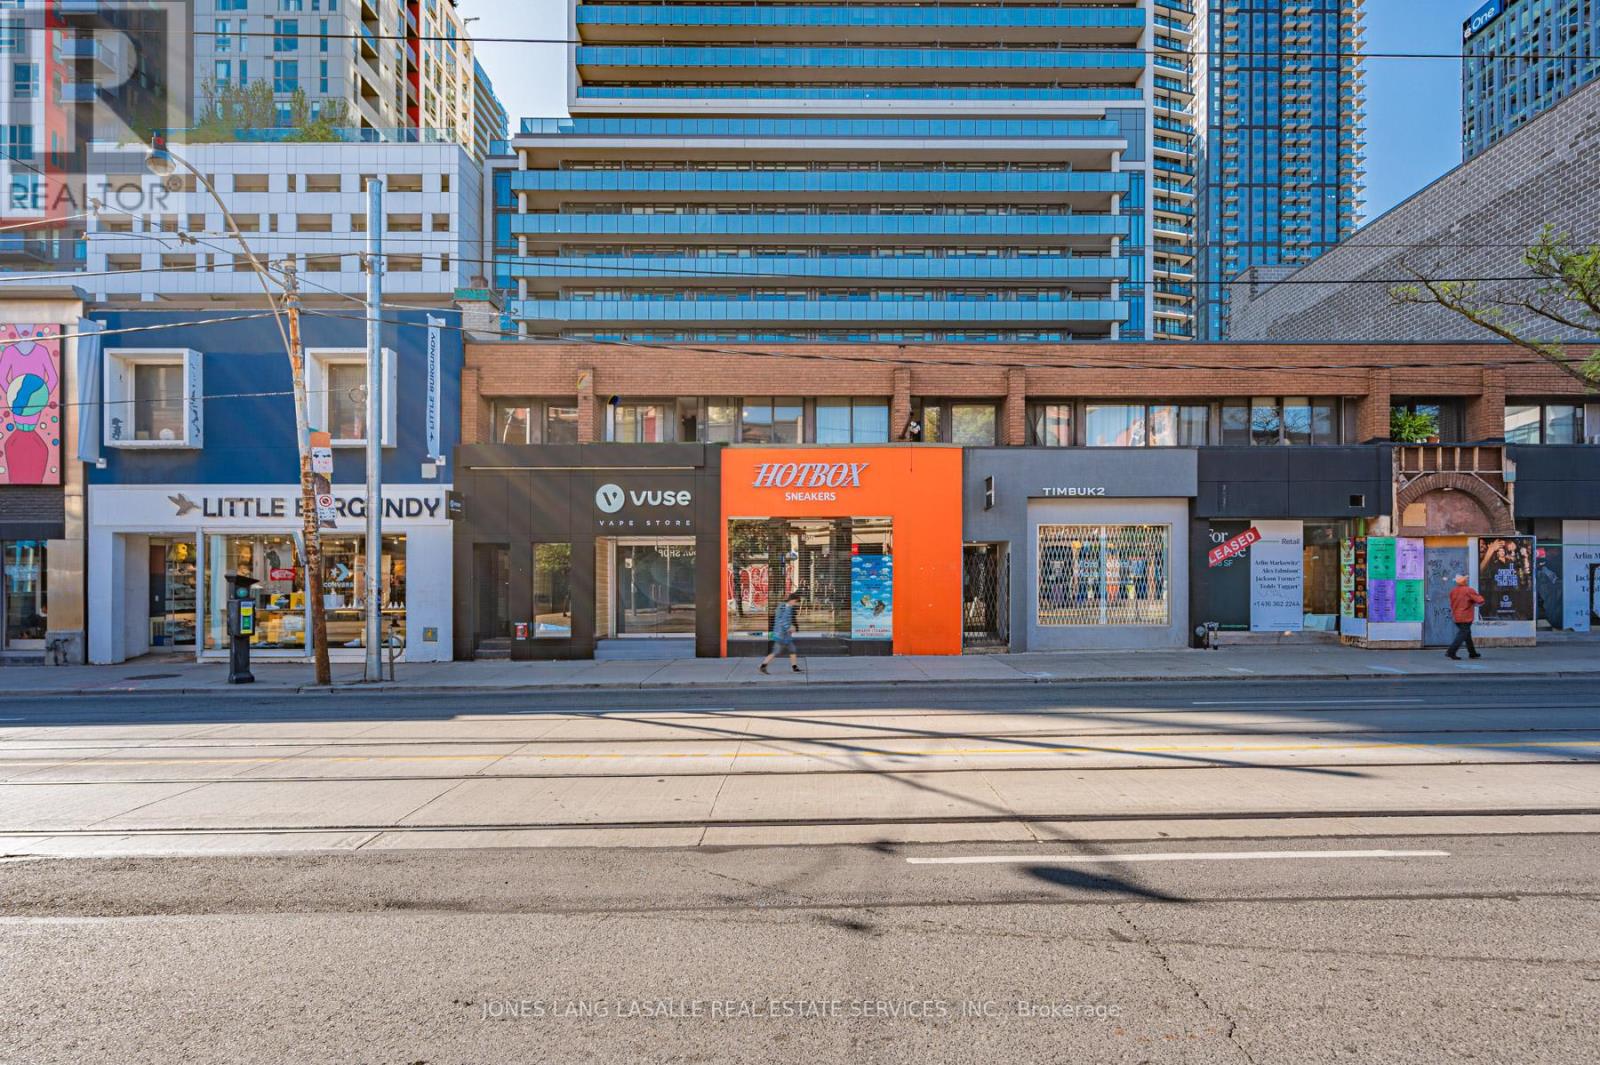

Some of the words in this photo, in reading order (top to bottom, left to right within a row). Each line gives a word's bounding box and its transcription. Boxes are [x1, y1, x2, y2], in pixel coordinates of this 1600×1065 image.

[752, 463, 868, 488] HOTBOX
[785, 492, 836, 501] SNEAKERS
[1042, 487, 1105, 496] TIMBUK2
[203, 497, 284, 518] LITTLE
[1208, 532, 1256, 563] LEASED
